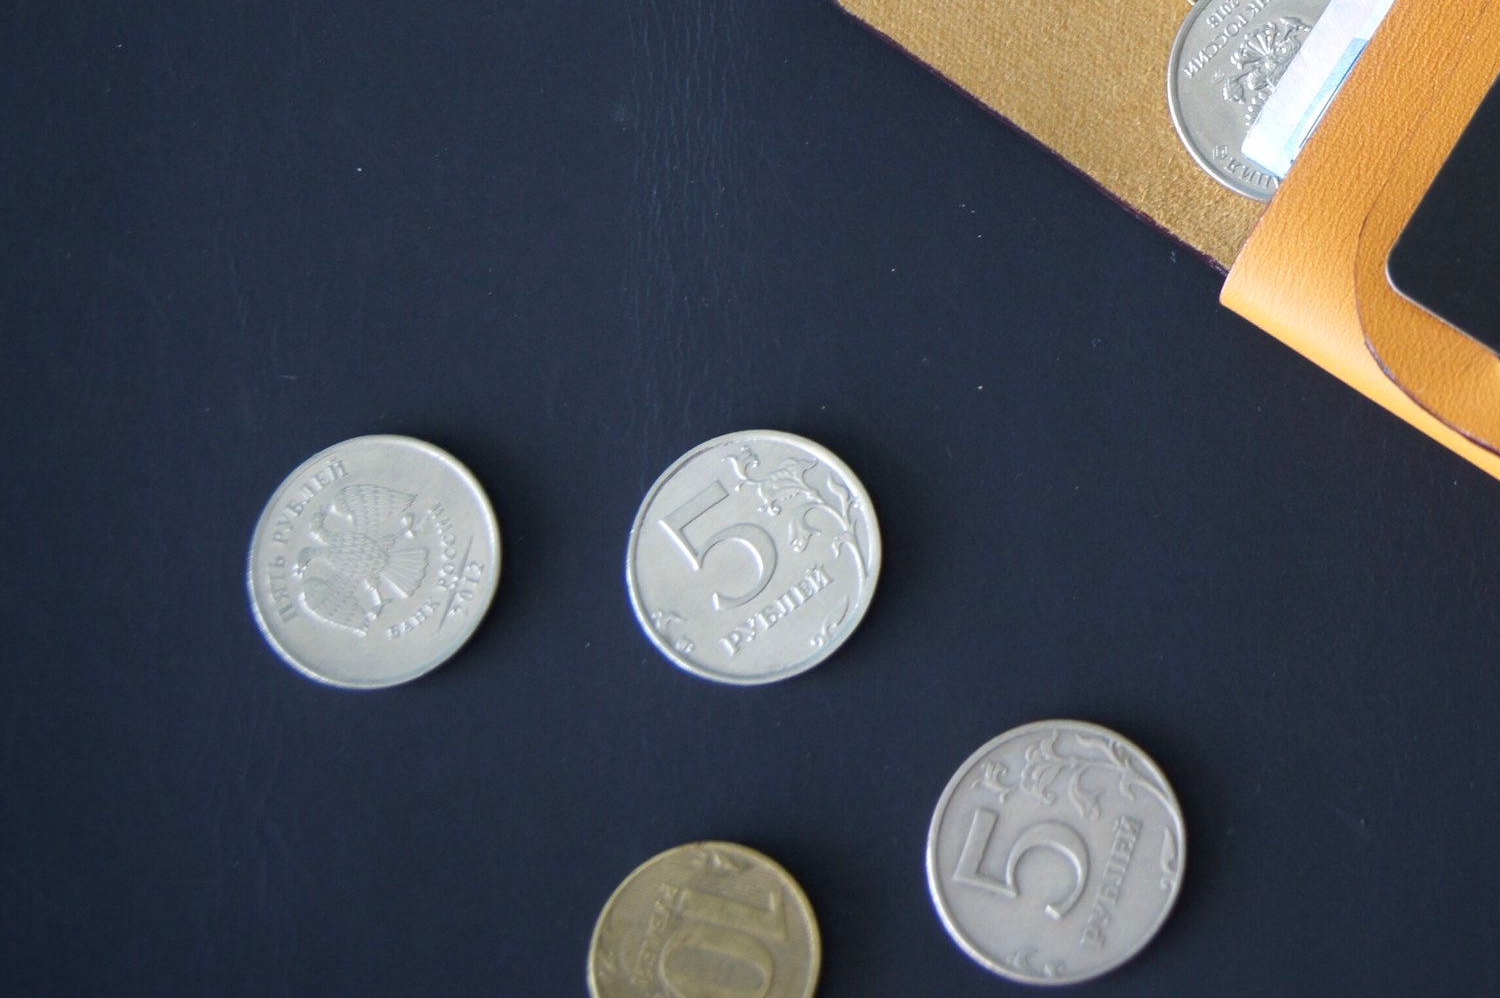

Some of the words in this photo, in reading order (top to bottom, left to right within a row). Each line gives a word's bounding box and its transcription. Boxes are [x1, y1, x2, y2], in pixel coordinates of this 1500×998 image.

[1183, 12, 1249, 79] РОССИИ
[273, 457, 350, 547] РУБЛЕЙ
[656, 478, 779, 612] 5
[267, 556, 299, 624] ПЯТЬ
[386, 596, 440, 642] БАНК
[427, 501, 458, 592] РОССИИ
[718, 562, 835, 659] РУБЛЕЙ
[952, 806, 1090, 922] 5
[1079, 815, 1145, 949] РУБЛЕЙ
[660, 885, 788, 998] 10
